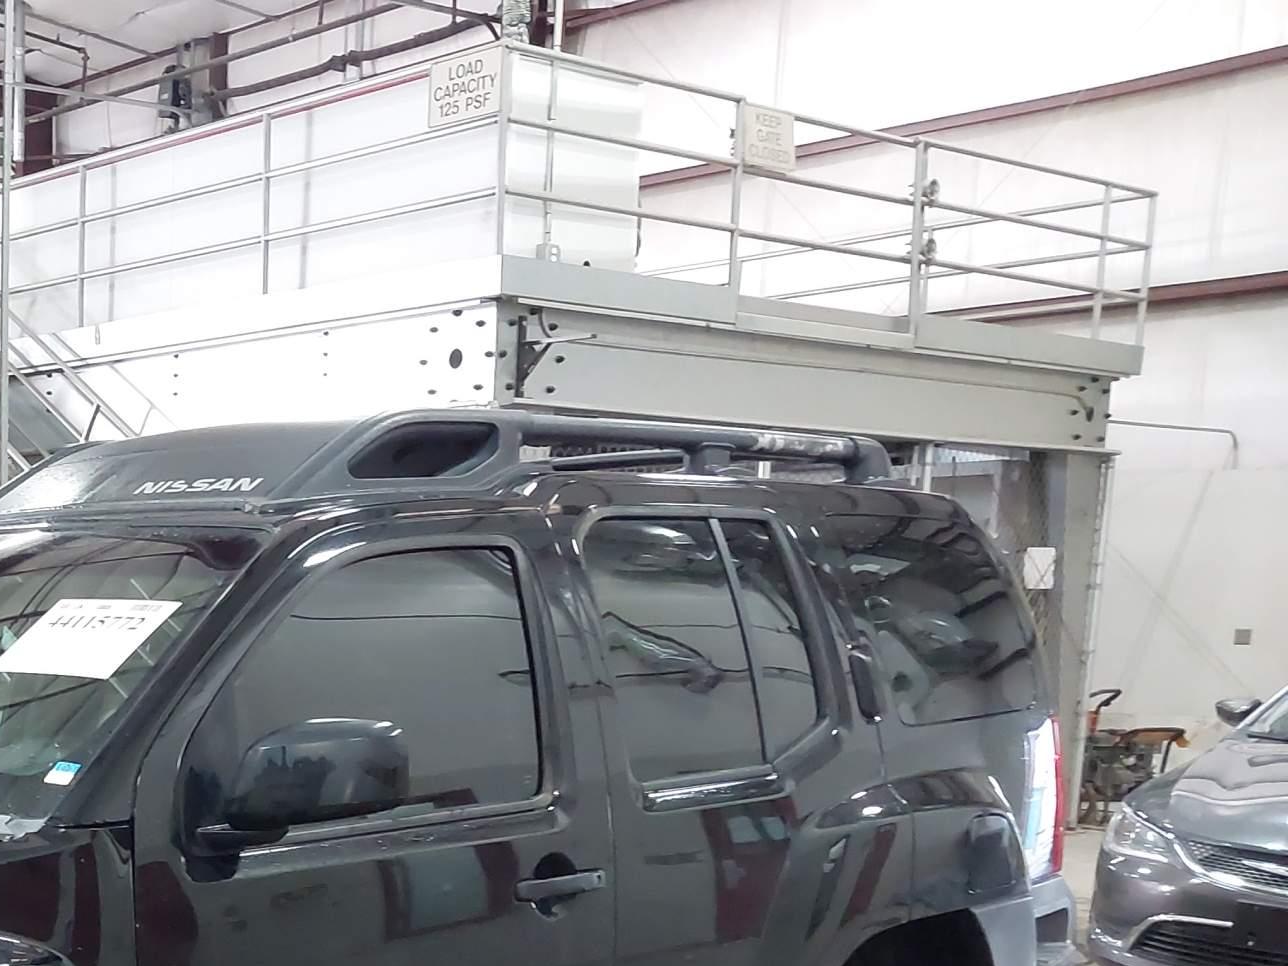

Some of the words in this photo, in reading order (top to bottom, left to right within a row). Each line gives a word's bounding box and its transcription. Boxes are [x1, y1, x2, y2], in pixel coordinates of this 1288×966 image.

[448, 59, 484, 81] LOAD
[433, 72, 497, 102] CAPACITY
[438, 100, 460, 118] 125
[465, 91, 492, 111] PSF
[132, 477, 264, 495] NISSAN
